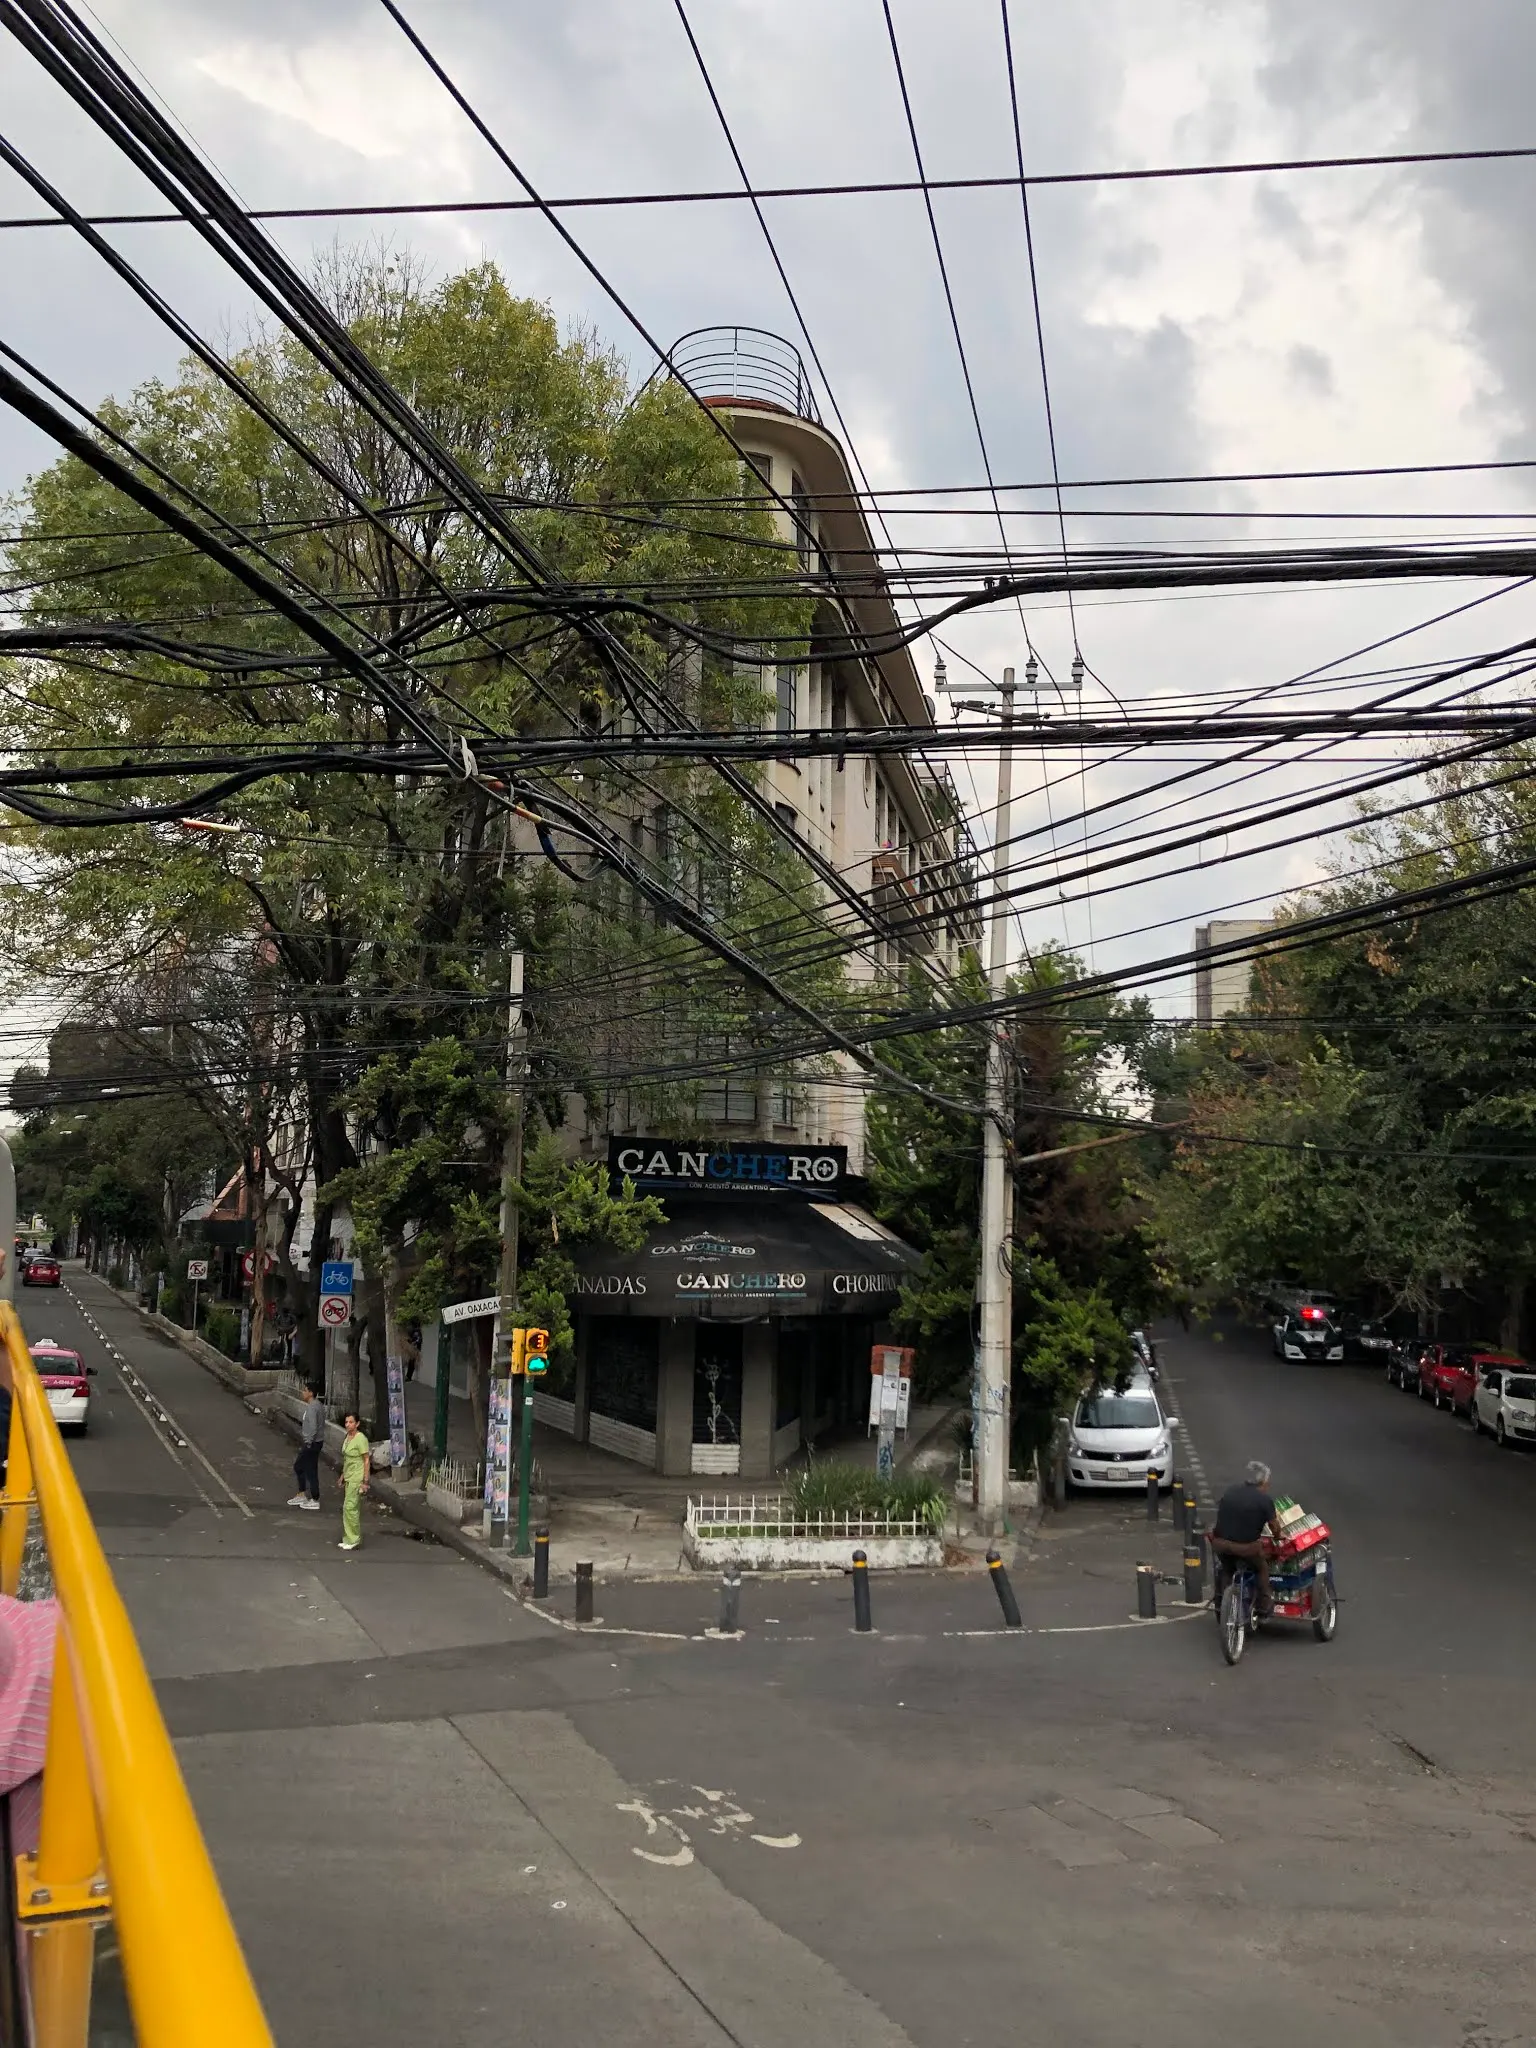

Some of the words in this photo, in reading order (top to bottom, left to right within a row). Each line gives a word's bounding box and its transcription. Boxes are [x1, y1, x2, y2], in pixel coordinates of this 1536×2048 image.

[617, 1148, 839, 1182] CANCHERO
[651, 1242, 756, 1256] CANCHERO
[676, 1272, 806, 1289] CANCHERO
[467, 1301, 498, 1314] OAXACA
